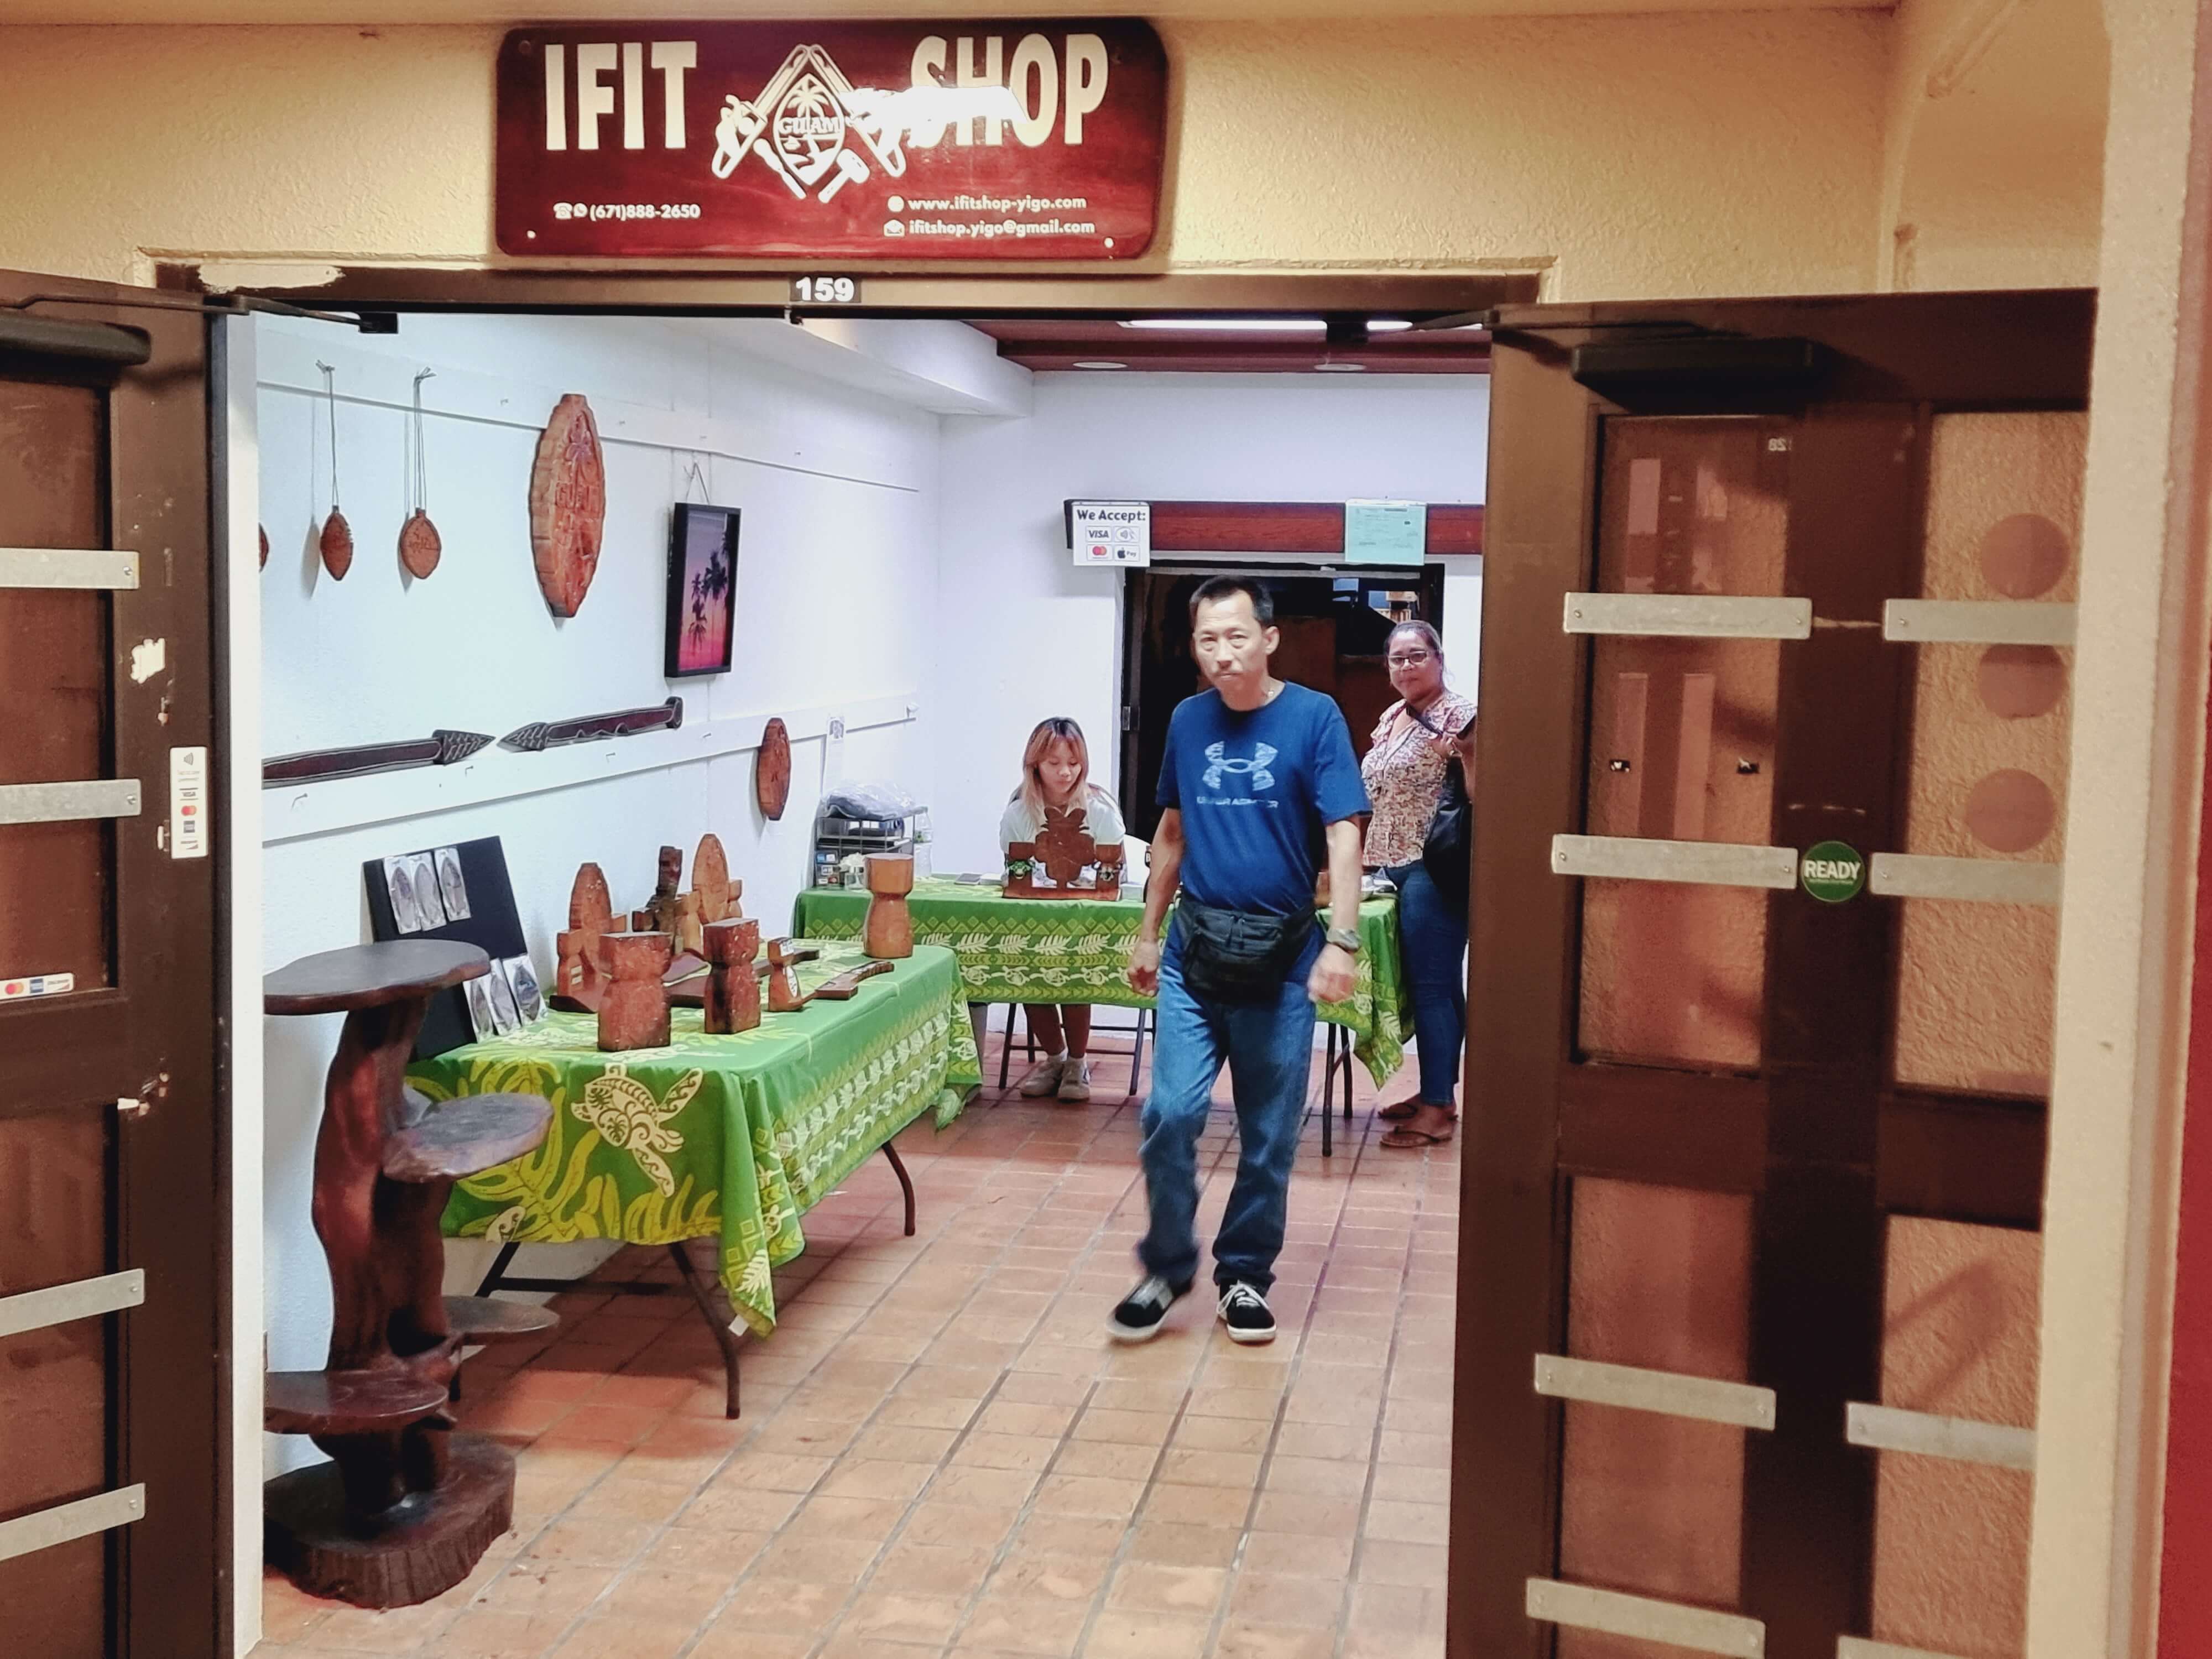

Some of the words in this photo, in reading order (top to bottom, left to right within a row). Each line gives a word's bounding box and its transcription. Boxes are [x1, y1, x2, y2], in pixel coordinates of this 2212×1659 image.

[545, 41, 697, 150] IFIT
[907, 33, 1108, 148] SHOP
[778, 117, 841, 134] GUAM
[907, 195, 1087, 212] www.ifitshop-yigo.com
[590, 204, 701, 221] (671)888-2650
[909, 219, 1095, 238] ifitshop.yigo@gmail.com
[796, 276, 854, 301] 159
[1077, 509, 1095, 520] We
[1098, 509, 1146, 523] Accept:
[1088, 530, 1109, 538] VISA
[1804, 859, 1861, 880] READY
